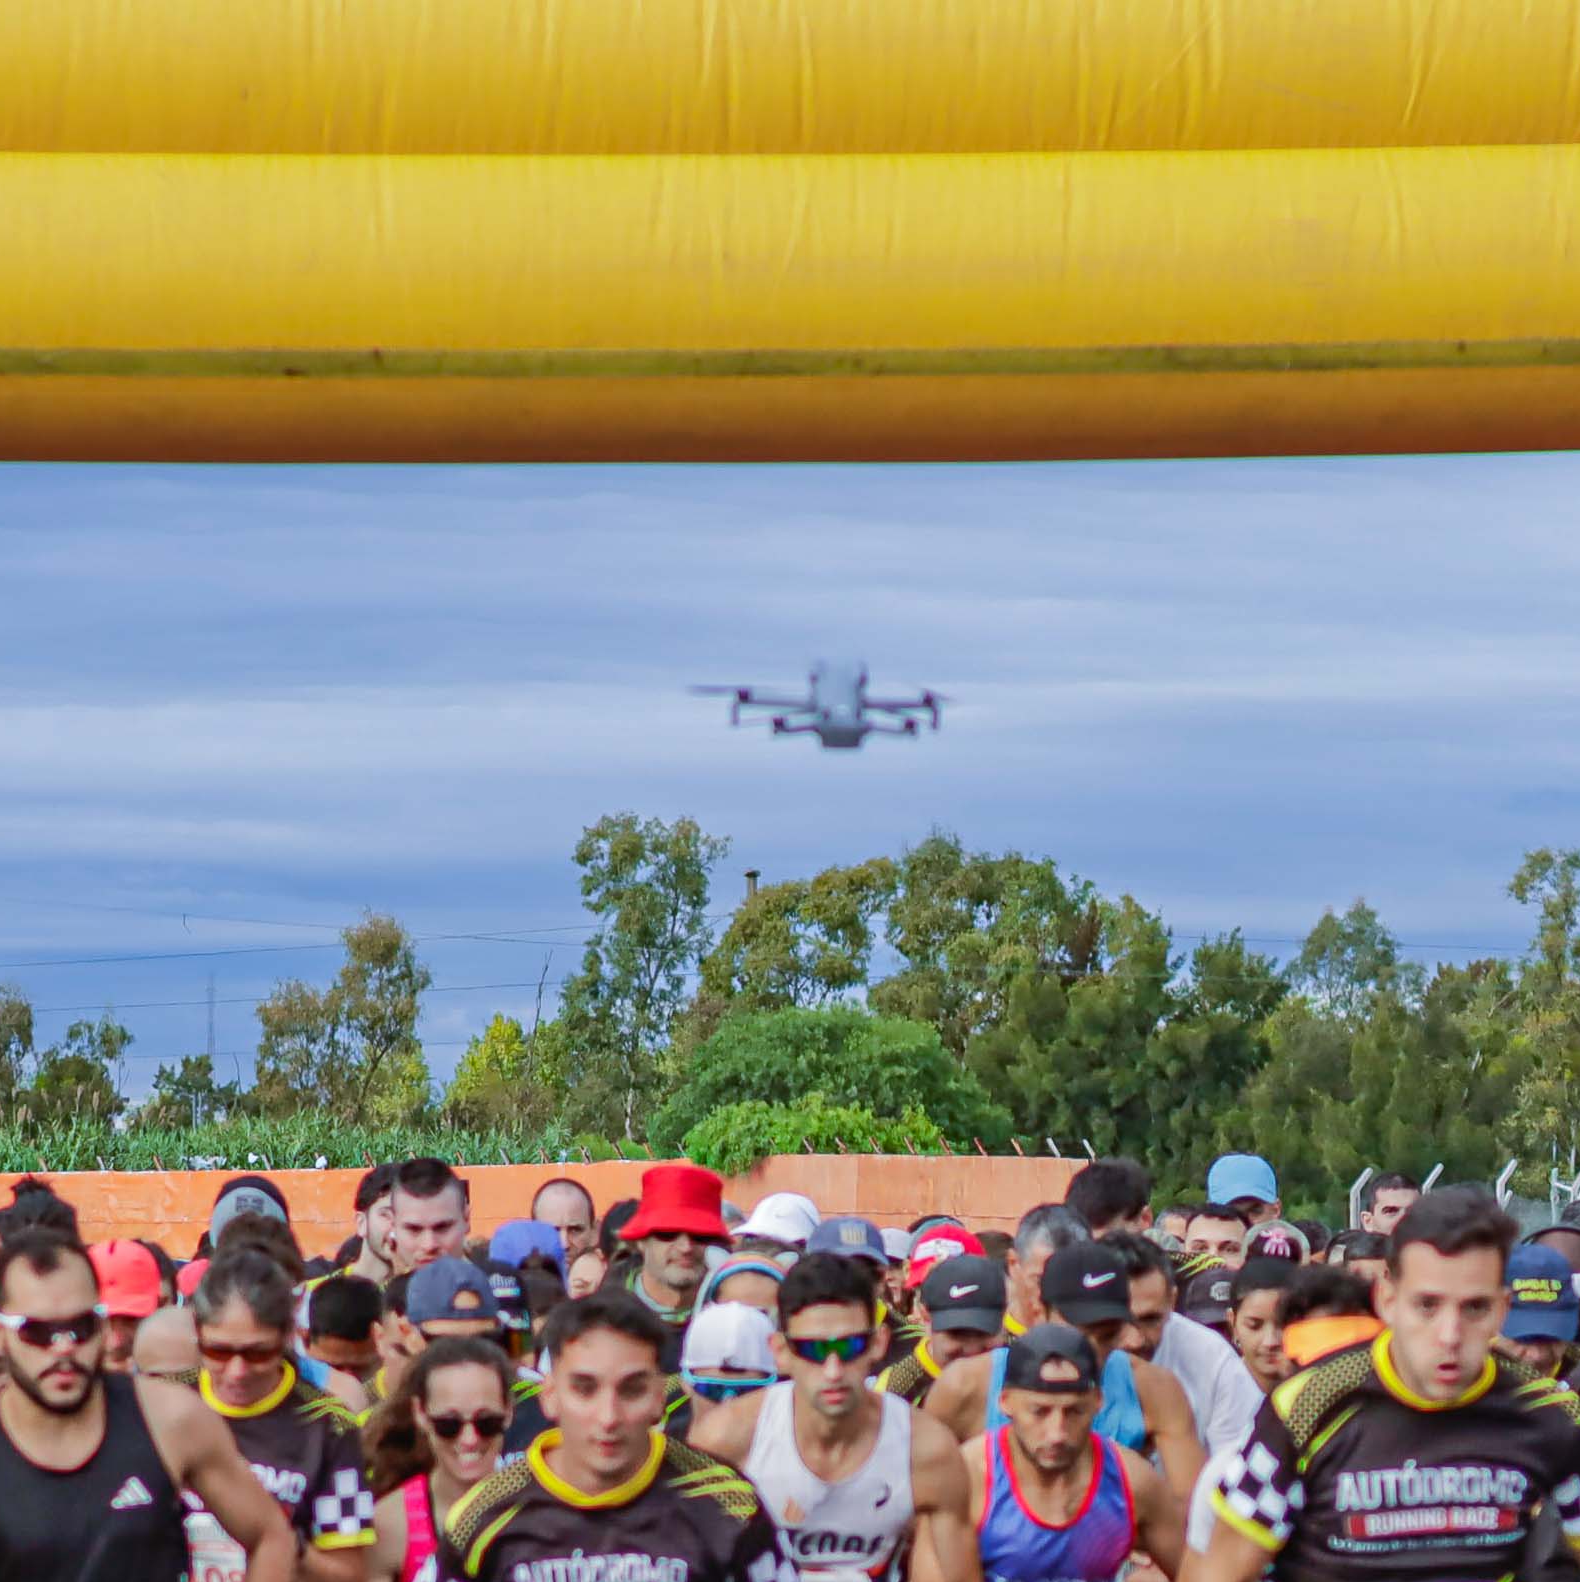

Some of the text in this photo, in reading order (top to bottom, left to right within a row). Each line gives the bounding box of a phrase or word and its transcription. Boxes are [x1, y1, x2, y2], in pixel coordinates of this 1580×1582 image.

[1334, 1458, 1528, 1513] AUTÓDROMO
[1364, 1505, 1500, 1538] RUNNING RACE
